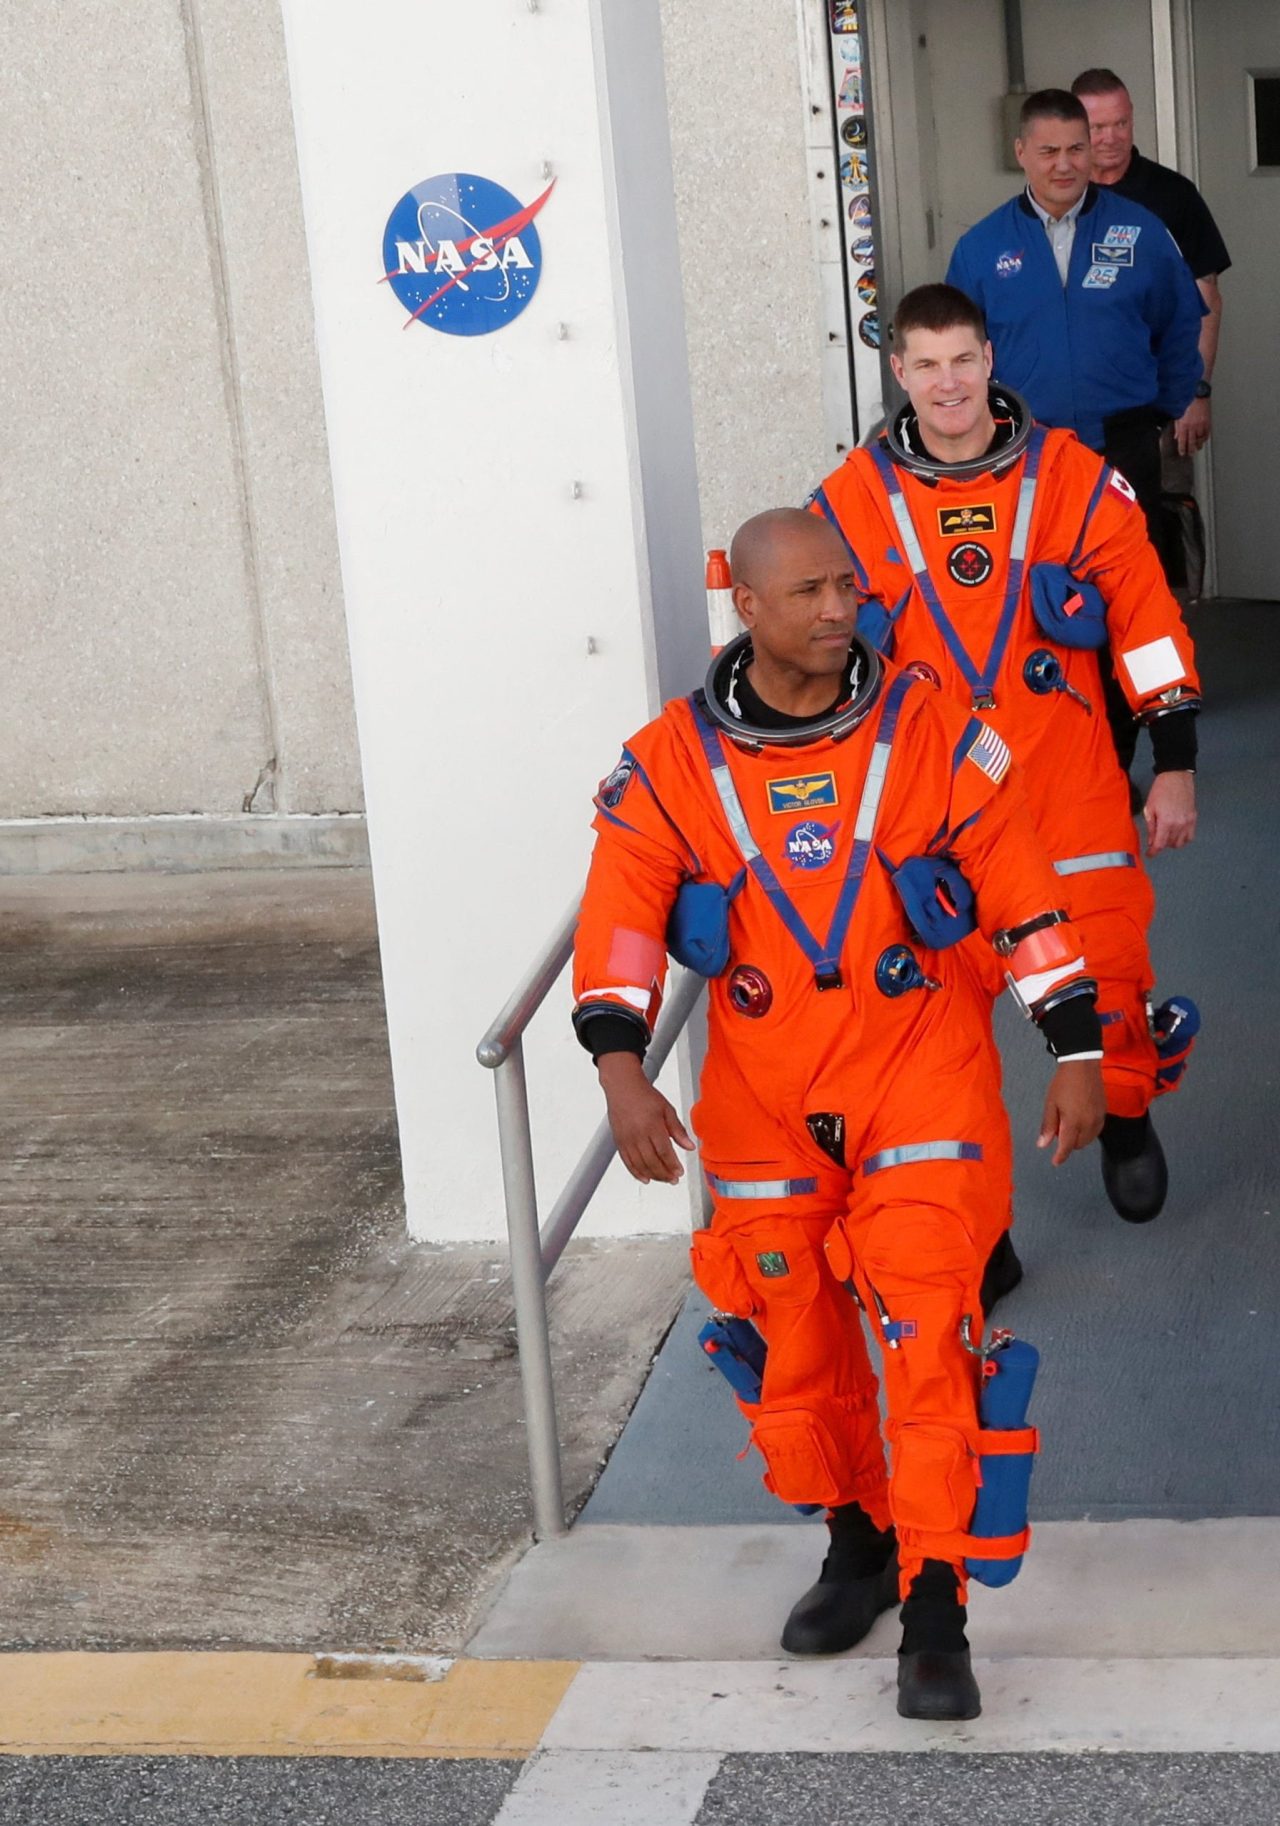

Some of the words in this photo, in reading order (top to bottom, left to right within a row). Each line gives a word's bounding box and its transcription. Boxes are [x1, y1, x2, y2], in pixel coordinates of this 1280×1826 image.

[395, 236, 535, 274] NASA
[996, 258, 1022, 271] NASA
[788, 838, 832, 853] NASA
